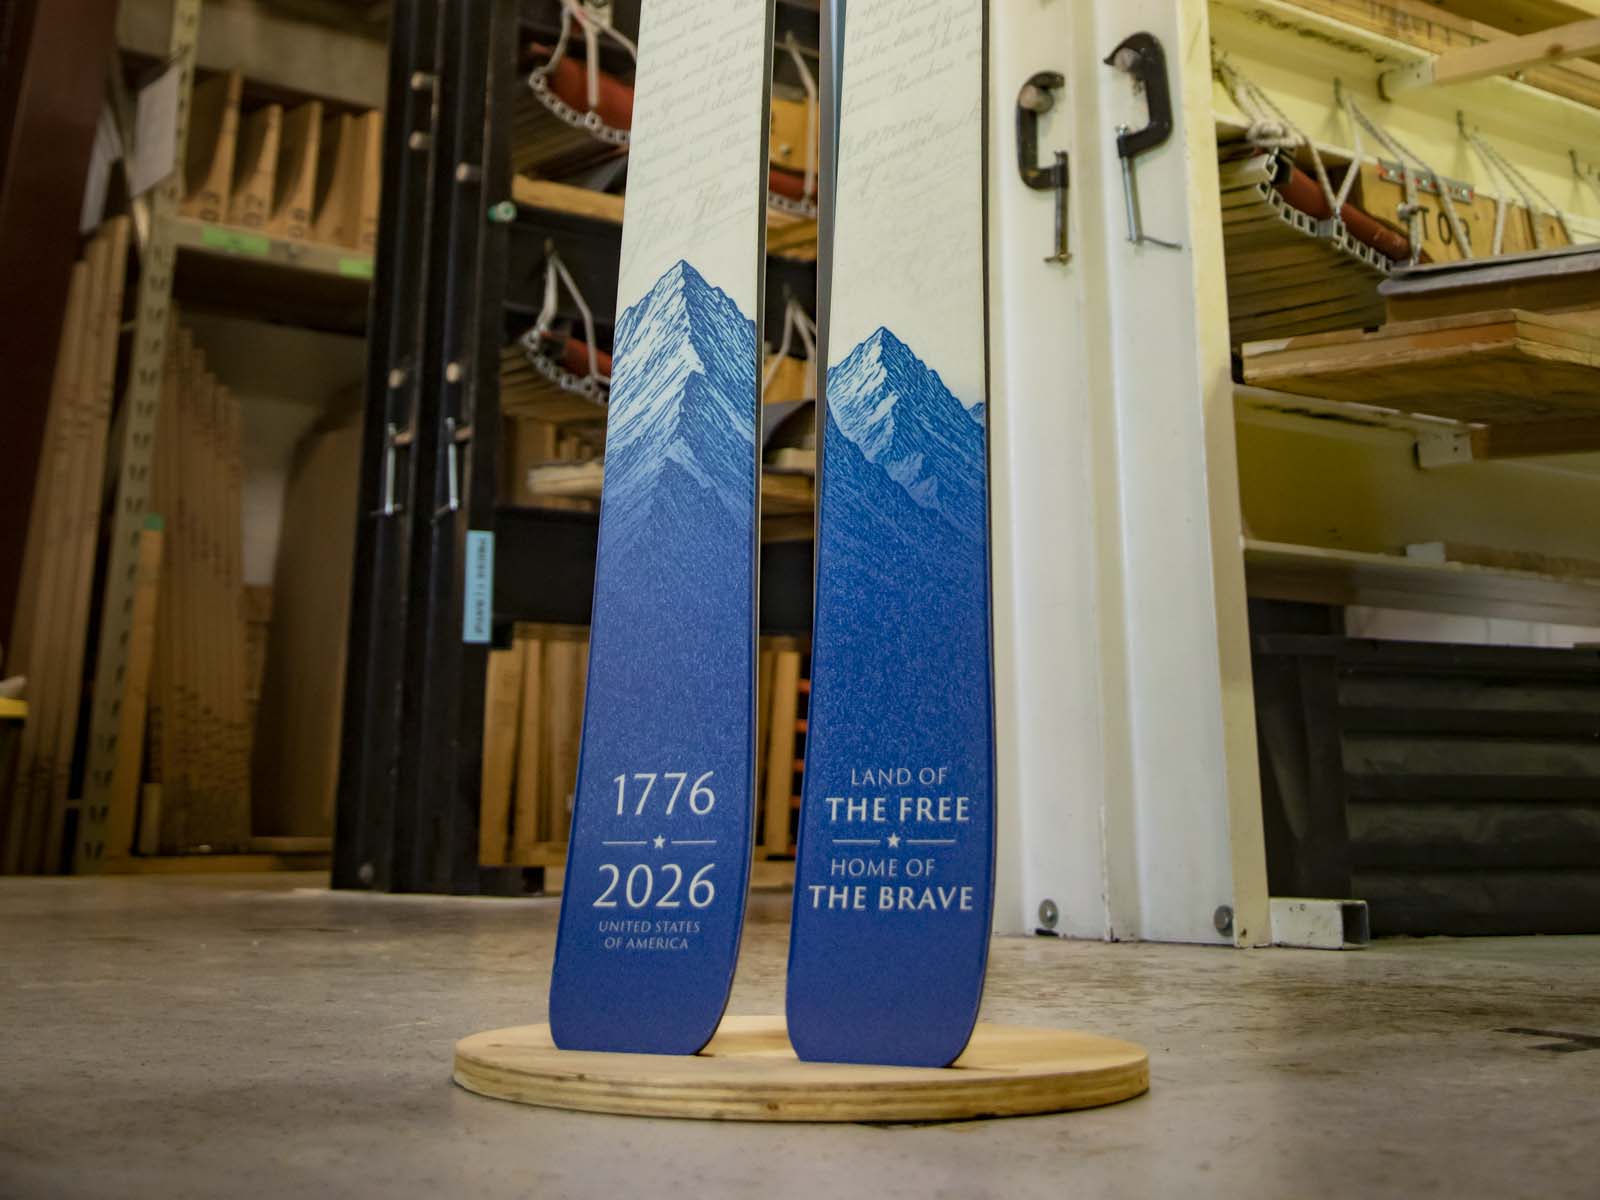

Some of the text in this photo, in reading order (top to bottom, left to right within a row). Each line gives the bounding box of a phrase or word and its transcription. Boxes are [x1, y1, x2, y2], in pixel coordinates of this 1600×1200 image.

[851, 767, 948, 785] LAND OF
[613, 770, 716, 816] 1776
[825, 797, 970, 822] THE FREE
[831, 858, 935, 877] HOME OF
[592, 862, 716, 909] 2026
[808, 885, 973, 911] THE BRAVE
[599, 920, 701, 933] UNITED STATES
[604, 936, 689, 950] OF AMERICA
